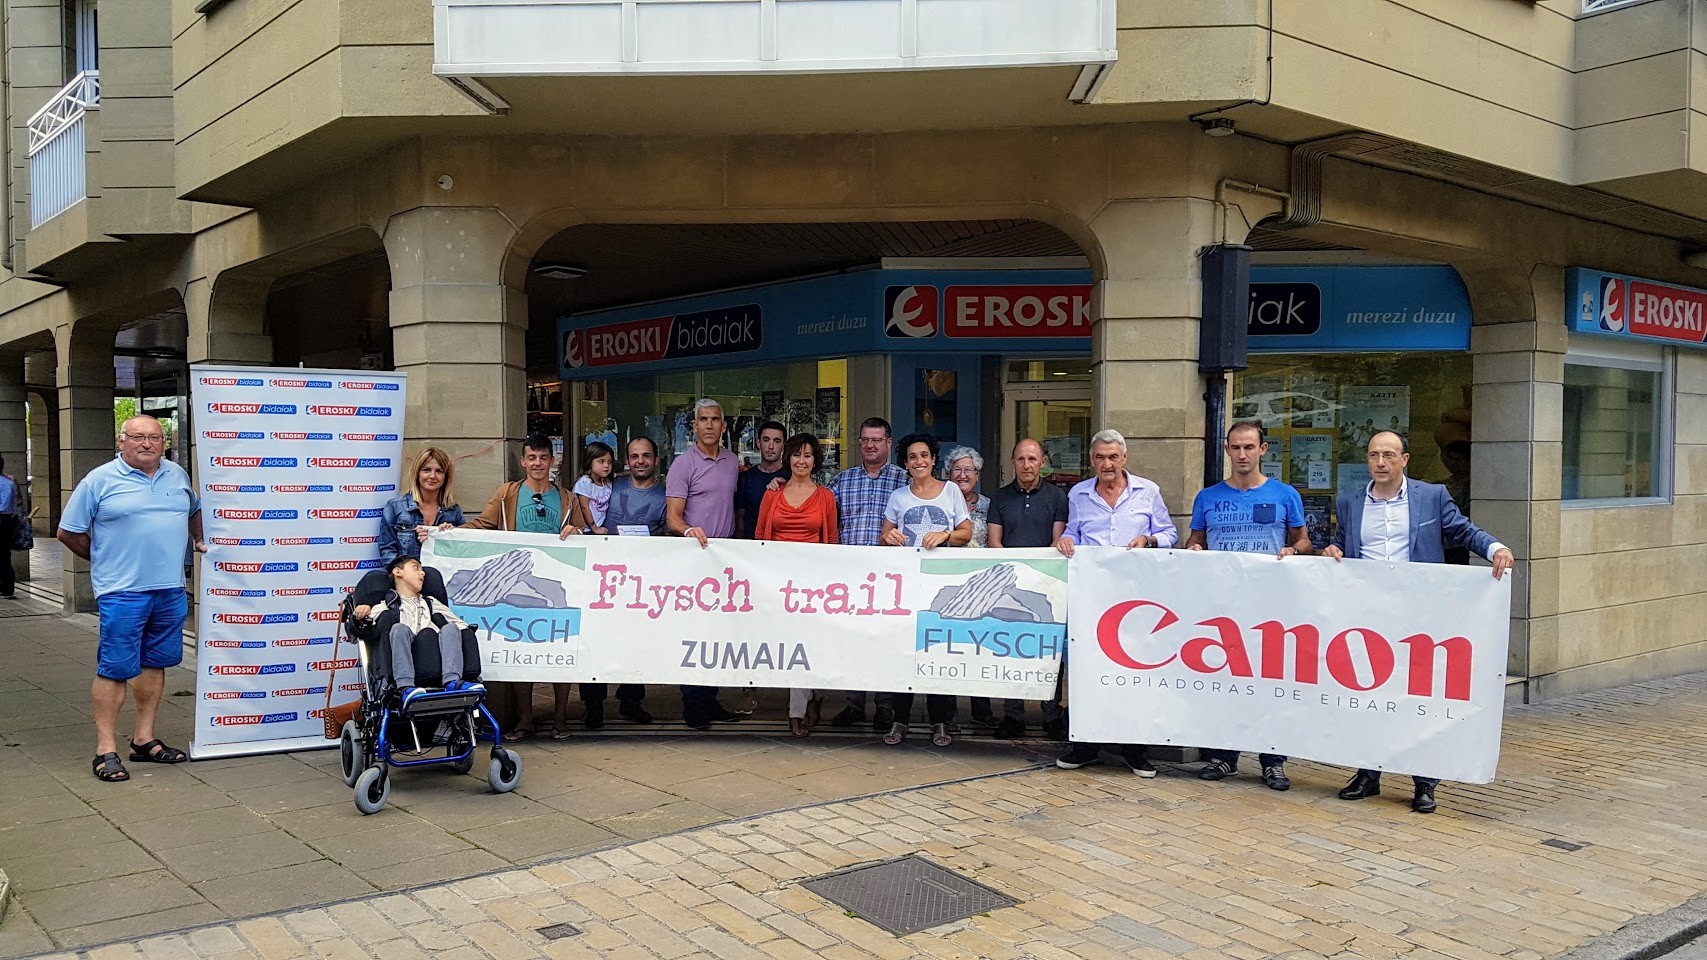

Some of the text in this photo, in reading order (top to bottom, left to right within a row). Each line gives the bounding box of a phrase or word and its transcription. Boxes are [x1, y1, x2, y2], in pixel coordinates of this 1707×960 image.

[956, 295, 1091, 327] EROSK
[1346, 308, 1456, 324] merezi duzu
[1634, 292, 1703, 331] EROSKI
[797, 314, 867, 335] merezi duzu
[591, 313, 754, 358] EROSKI bidaiak
[222, 404, 294, 413] EROSKI bidaiak
[320, 407, 389, 416] EROSKI bidaiak
[224, 457, 295, 466] EROSKI bidaiak
[321, 458, 389, 467] EROSKI bidaiak
[1214, 500, 1238, 513] KRS
[226, 510, 295, 518] EROSKI bidaiak
[321, 509, 383, 518] EROSKI bidaia
[1221, 525, 1241, 533] DOWN
[1218, 541, 1235, 551] TKY
[1251, 541, 1269, 551] JPN
[265, 563, 295, 571] bidaiak
[321, 562, 354, 570] EROSKI
[589, 563, 912, 619] Flysch trail
[226, 614, 295, 623] EROSKI bidaiak
[321, 612, 339, 620] ERO
[923, 628, 1058, 661] FLYSCH
[680, 641, 811, 671] ZUMAIA
[1096, 599, 1473, 702] Canon
[490, 649, 575, 666] Elkartea
[223, 665, 293, 674] EROSKI bidaiak
[916, 662, 968, 679] Kirol
[1100, 674, 1466, 721] COPIADORAS DE EIBAR S.L.
[225, 713, 294, 724] EROSKI bidaiak
